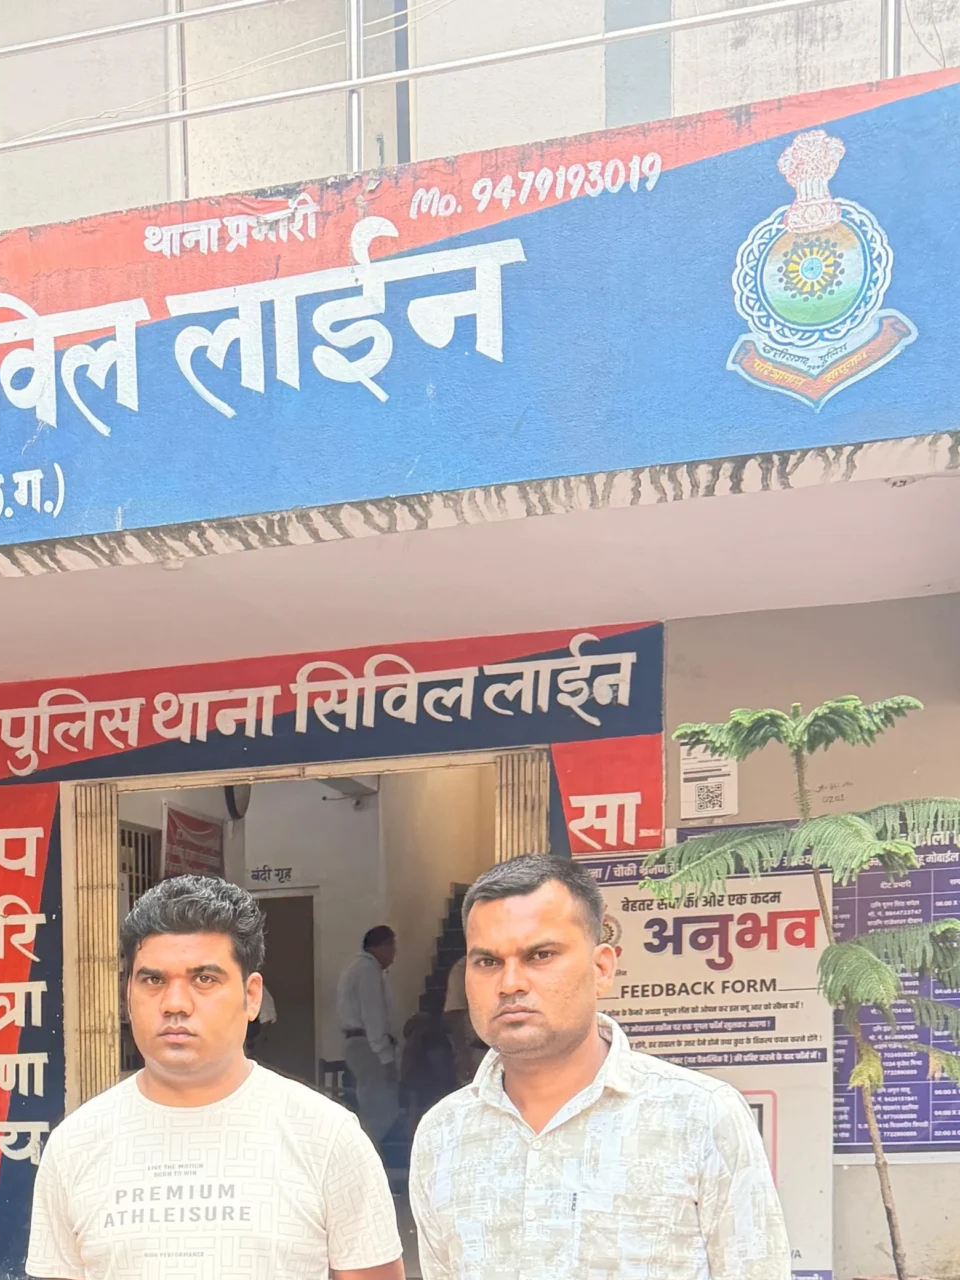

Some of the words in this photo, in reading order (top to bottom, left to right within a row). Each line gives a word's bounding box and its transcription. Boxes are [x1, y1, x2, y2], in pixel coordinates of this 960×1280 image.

[410, 187, 461, 219] Mo.
[472, 153, 662, 212] 9479193019
[144, 218, 221, 259] थाना
[166, 215, 527, 418] लाईन
[152, 685, 281, 744] थाना
[292, 653, 479, 736] सिविल
[483, 633, 637, 727] लाईन
[568, 791, 642, 851] सा
[251, 864, 272, 882] बंदी
[275, 866, 293, 884] गृह
[613, 862, 638, 878] चौकी
[621, 896, 654, 912] बेहतर
[727, 894, 747, 906] एक
[749, 891, 782, 905] कदम
[643, 909, 820, 971] अनुभव
[620, 982, 715, 999] FEEDBACK
[721, 978, 778, 994] FORM
[115, 1183, 236, 1205] PREMIUM
[103, 1205, 252, 1229] ATHLEISURE
